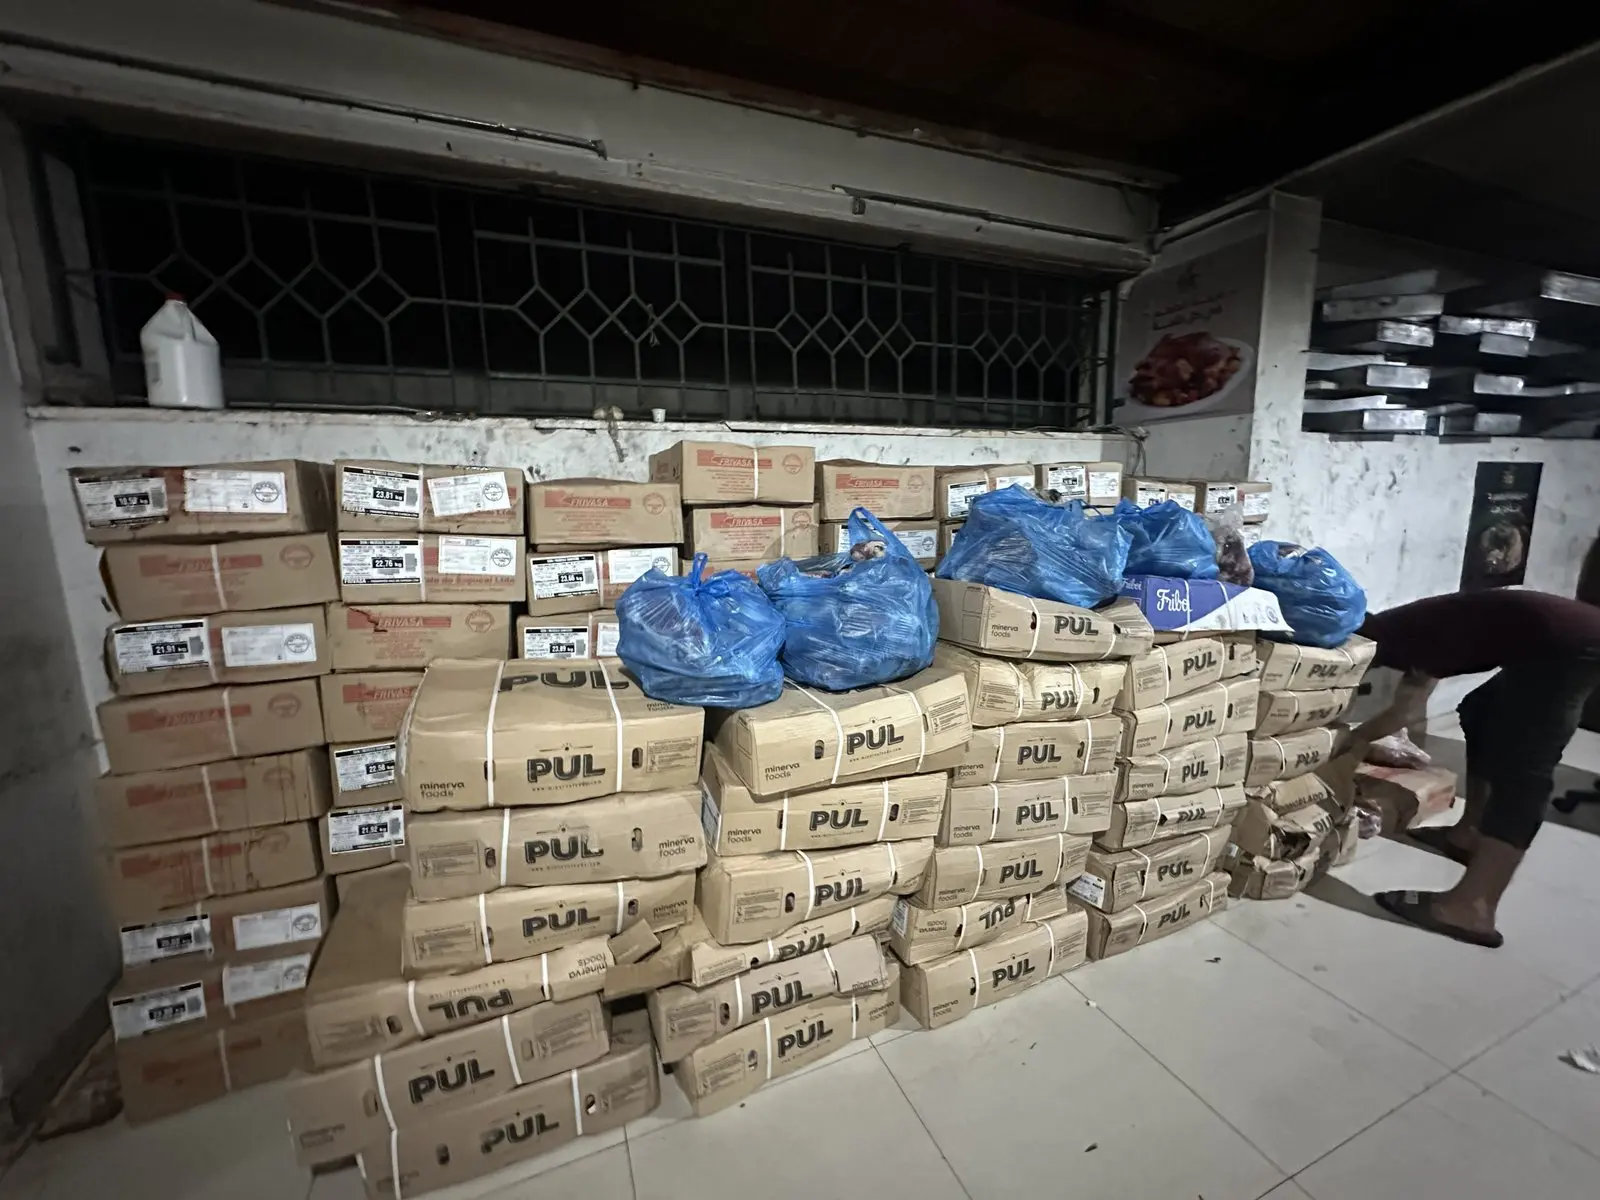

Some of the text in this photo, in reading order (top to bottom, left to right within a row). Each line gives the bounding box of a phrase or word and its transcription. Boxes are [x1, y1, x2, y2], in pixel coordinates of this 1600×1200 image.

[718, 457, 753, 467] FRIVASA
[570, 497, 609, 507] FRIVASA
[730, 518, 764, 527] FRIVASA
[375, 559, 393, 568] 22.76
[378, 616, 425, 627] FRIVASA
[991, 624, 1019, 632] minerva
[1053, 615, 1099, 636] PUL
[1183, 651, 1217, 675] PUL
[498, 669, 629, 692] PUL
[1040, 690, 1080, 711] PUL
[1183, 710, 1217, 731] PUL
[846, 723, 905, 756] PUL
[1017, 744, 1062, 765] PUL
[527, 753, 606, 783] PUL
[764, 762, 801, 774] minerva
[764, 770, 792, 782] foods
[958, 762, 984, 771] minerva
[1182, 760, 1209, 782] PUL
[419, 780, 465, 790] minerva
[420, 788, 454, 798] foods
[809, 808, 869, 832] PUL
[1015, 801, 1059, 825] PUL
[727, 826, 762, 837] minerva
[953, 824, 981, 832] minerva
[524, 835, 605, 864] PUL
[658, 836, 695, 850] minerva
[727, 834, 753, 844] foods
[659, 846, 686, 858] foods
[1000, 859, 1044, 883] PUL
[1157, 863, 1194, 881] PUL
[814, 877, 869, 907] PUL
[521, 907, 601, 938] PUL
[1158, 904, 1190, 928] PUL
[778, 933, 832, 959] PUL
[568, 963, 608, 980] minerva
[992, 957, 1036, 989] PUL
[428, 988, 514, 1021] PUL
[751, 980, 814, 1016] PUL
[777, 1019, 834, 1058] PUL
[408, 1057, 496, 1104] PUL
[480, 1112, 560, 1155] PUL
